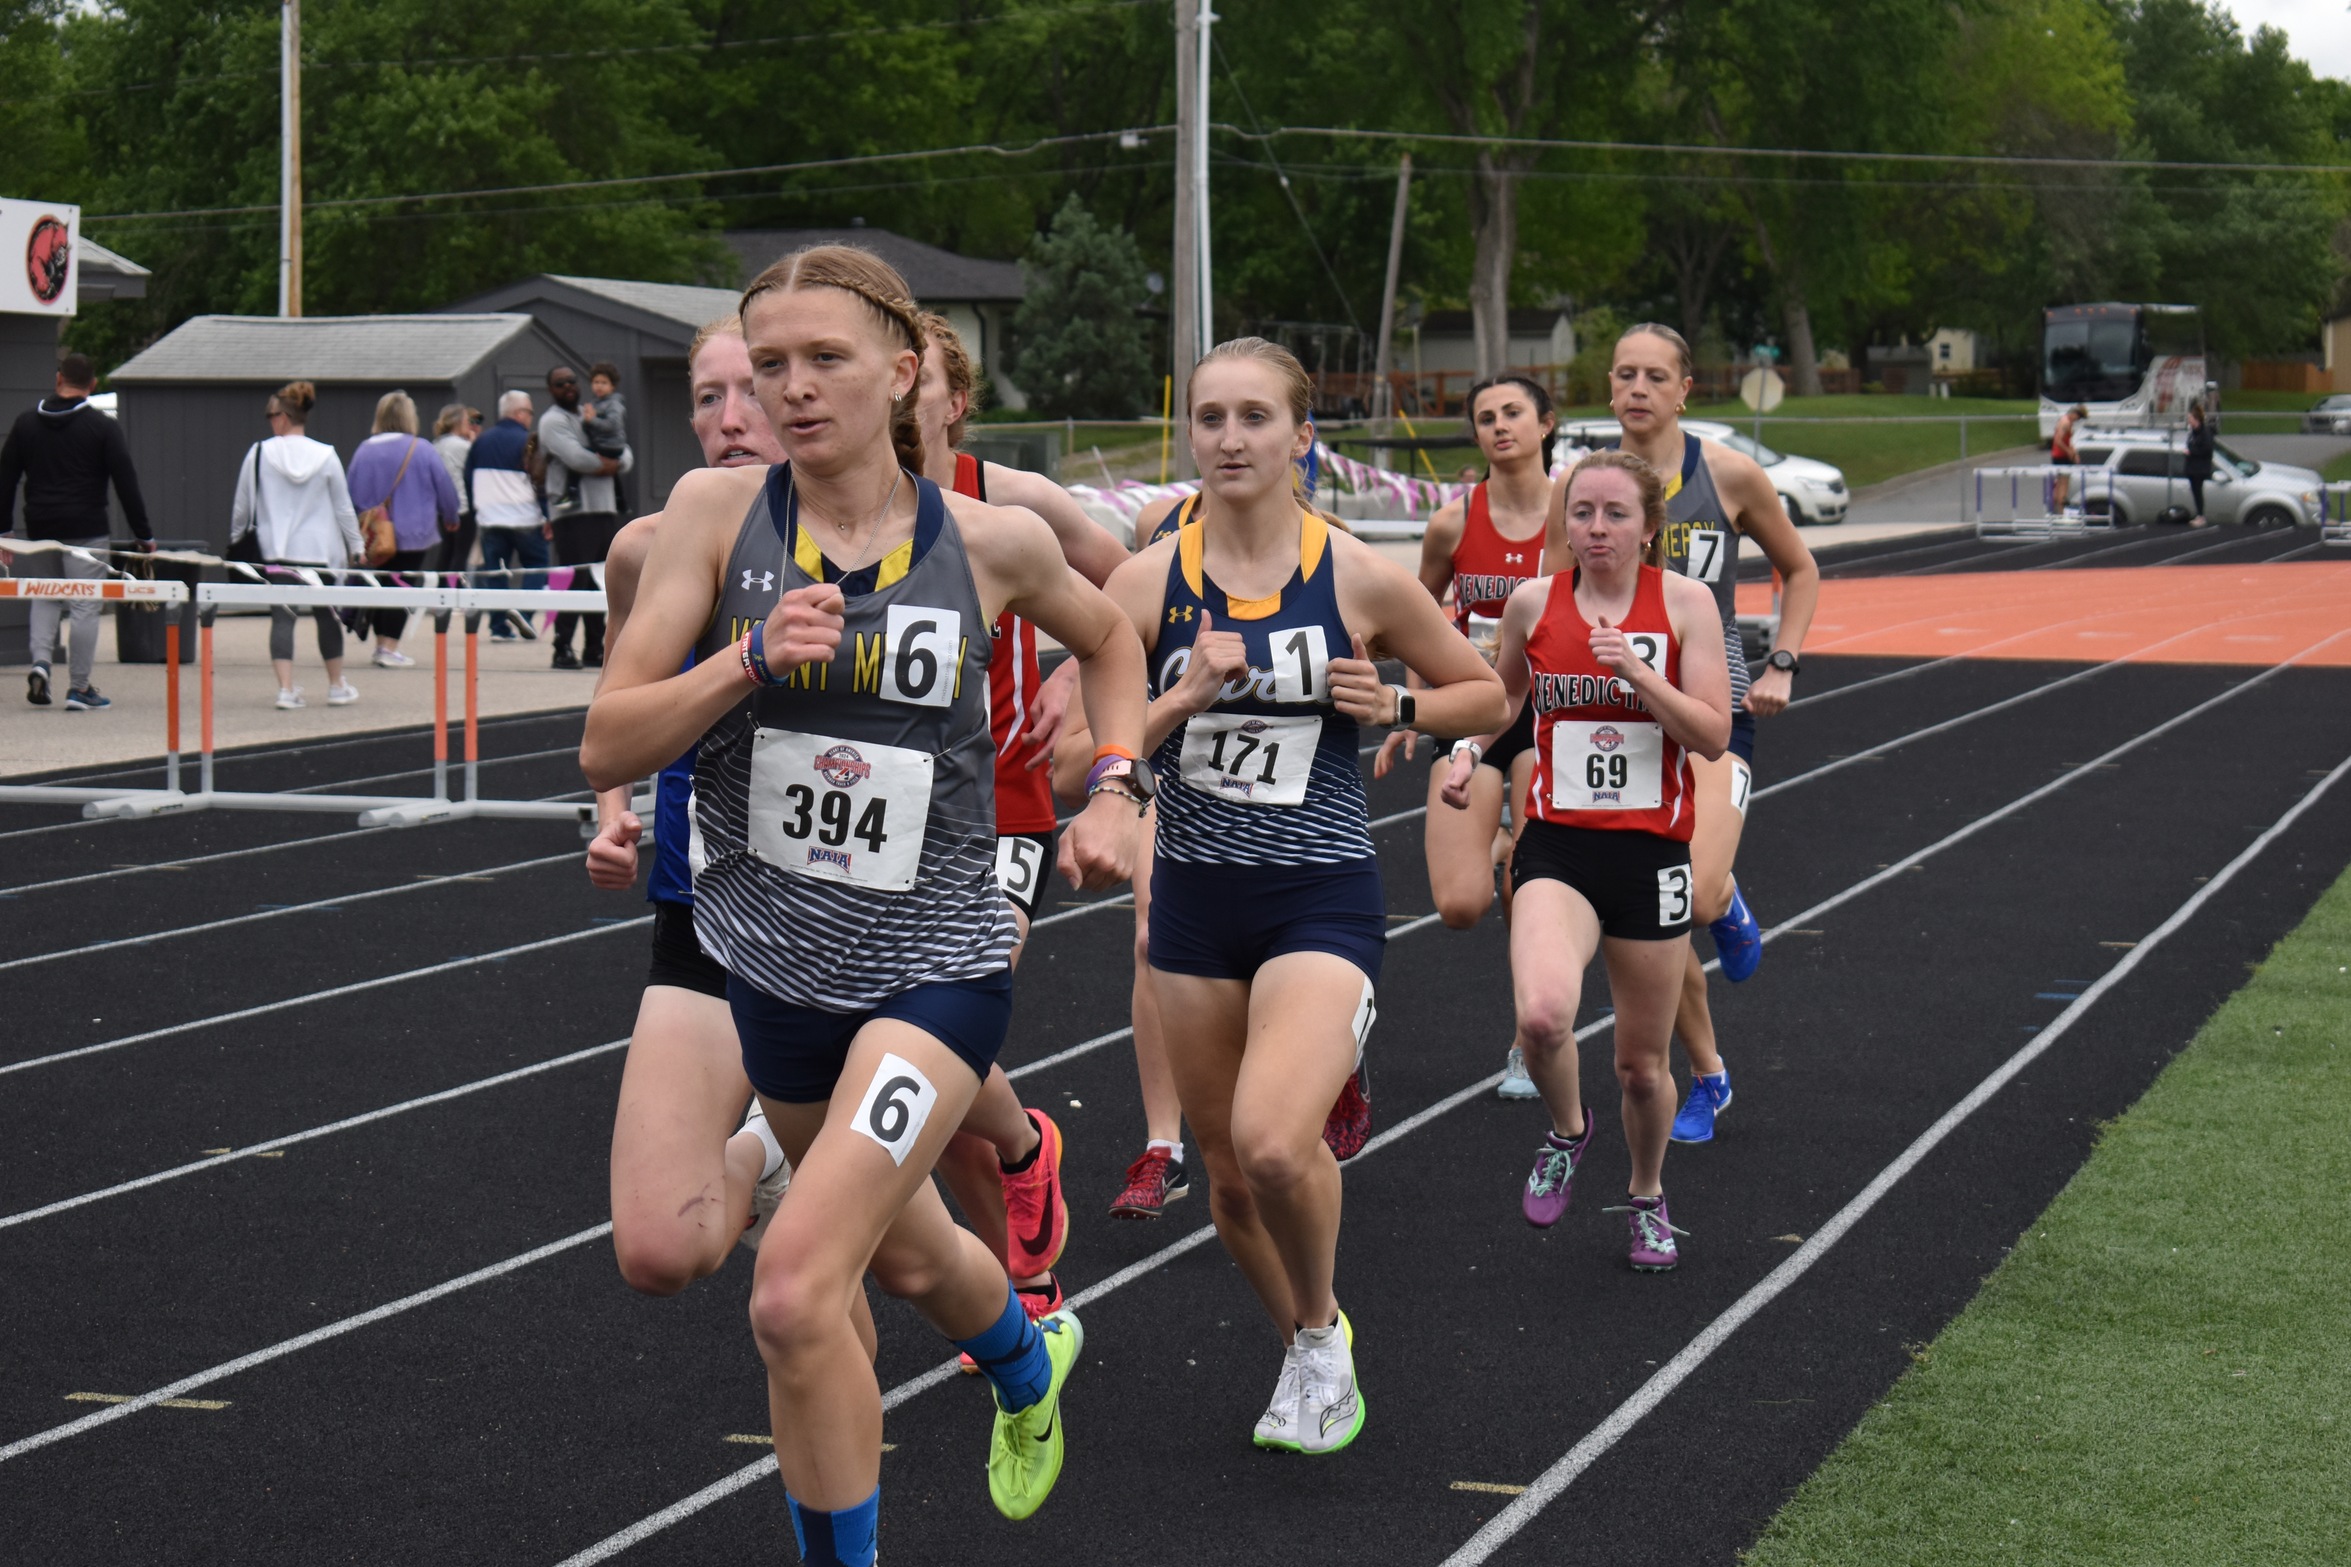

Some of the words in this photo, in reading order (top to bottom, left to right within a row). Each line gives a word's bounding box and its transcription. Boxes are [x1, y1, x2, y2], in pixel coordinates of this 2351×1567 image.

[1698, 534, 1719, 578] 7
[25, 582, 96, 596] WILDCATS
[128, 586, 156, 595] UCS
[895, 620, 938, 699] 6
[1285, 631, 1313, 696] 1
[1630, 636, 1657, 672] 3
[1208, 730, 1280, 785] 171
[1586, 753, 1627, 788] 69
[1221, 778, 1251, 796] NAIA
[1593, 791, 1620, 801] NAIA
[1738, 767, 1749, 809] 7
[783, 784, 887, 853] 394
[809, 847, 849, 869] NAIA
[1007, 838, 1036, 893] 5
[1668, 868, 1688, 920] 3
[869, 1075, 921, 1143] 6
